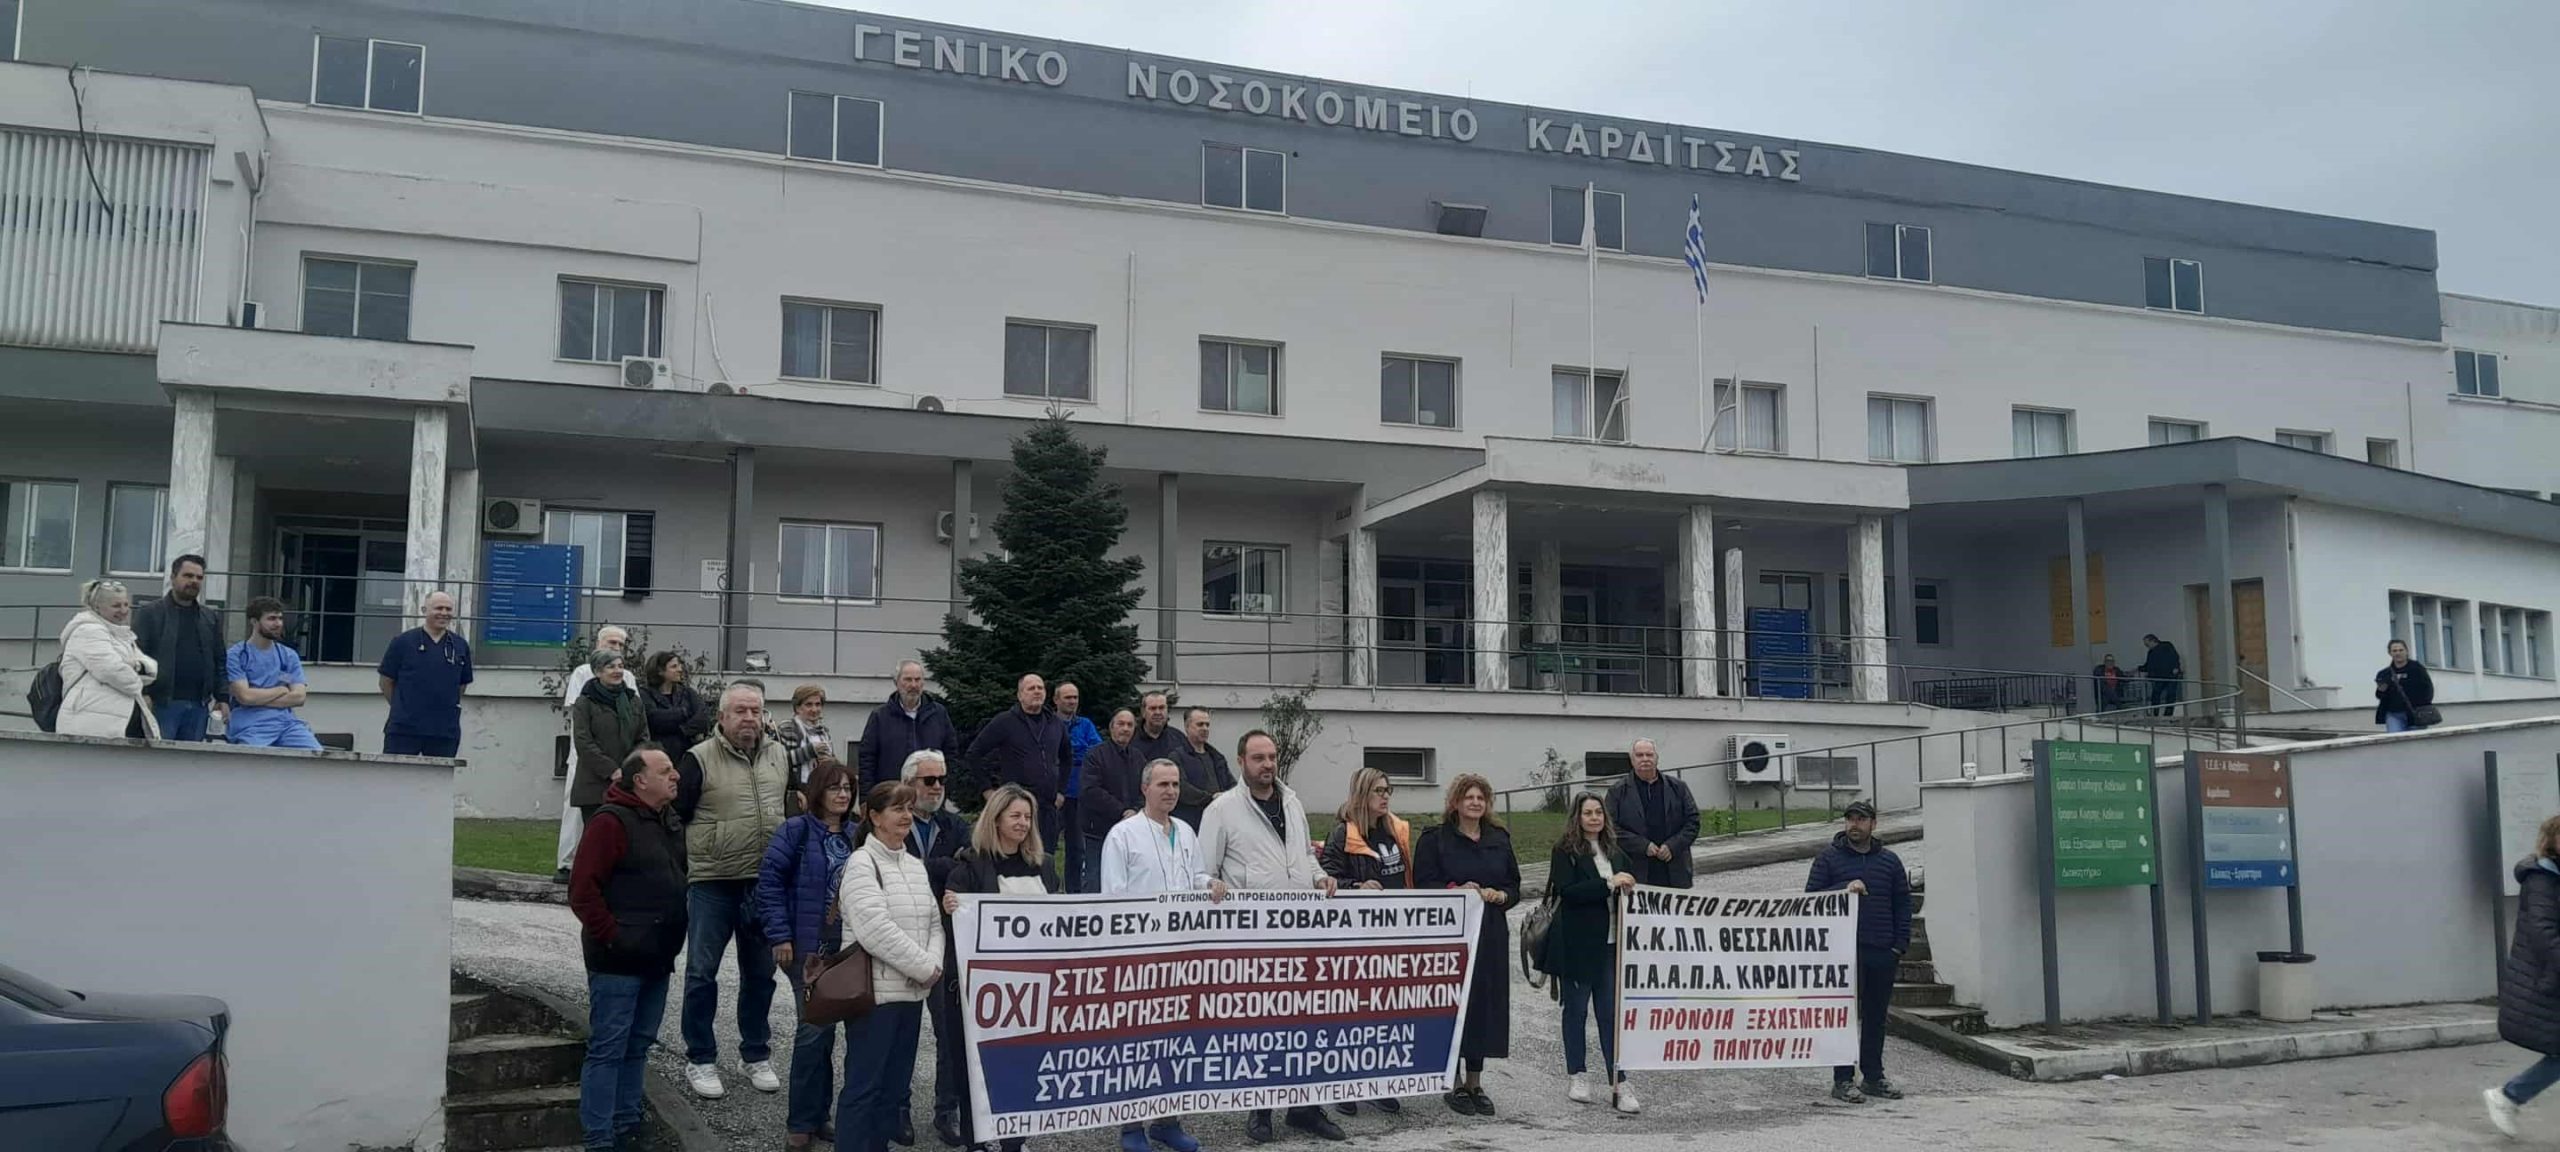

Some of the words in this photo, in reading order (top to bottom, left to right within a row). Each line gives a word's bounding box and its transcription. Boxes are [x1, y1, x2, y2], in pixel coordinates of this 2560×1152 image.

[855, 23, 1069, 87] ΓΕΝΙΚΟ
[1127, 61, 1479, 142] ΝΟΣΟΚΟΜΕΙΟ
[1527, 116, 1802, 181] ΚΑΡΔΙΤΣΑΣ
[1158, 894, 1168, 904] ΟΙ
[1238, 892, 1326, 902] ΠΡΟΕΙΔΟΠΟΙΟΥΝ:
[1627, 890, 1720, 917] ΣΩΜΑΤΕΙΟ
[1721, 893, 1850, 918] ΕΡΓΑΖΟΜΕΝΩΝ
[994, 915, 1031, 938] ΤΟ
[1040, 915, 1104, 938] «ΝΕΟ
[1110, 912, 1161, 935] ΕΣΥ»
[1167, 909, 1258, 932] ΒΛΑΠΤΕΙ
[1266, 908, 1352, 929] ΣΟΒΑΡΑ
[1358, 908, 1398, 928] ΤΗΝ
[1404, 907, 1457, 926] ΥΓΕΙΑ
[1626, 926, 1713, 952] Κ.Κ.Π.Π.
[1719, 927, 1830, 952] ΘΕΣΣΑΛΙΑΣ
[1052, 966, 1107, 998] ΣΤΙΣ
[1113, 956, 1309, 993] ΙΔΙΩΤΙΚΟΠΟΙΗΣΕΙΣ
[1314, 951, 1461, 982] ΣΥΓΧΩΝΕΥΣΕΙΣ
[1624, 964, 1731, 990] Π.Α.Α.Π.Α.
[1736, 964, 1850, 990] ΚΑΡΔΙΤΣΑΣ
[975, 982, 1042, 1030] ΟΧΙ
[1050, 993, 1192, 1034] ΚΑΤΑΡΓΗΣΕΙΣ
[1198, 983, 1463, 1020] ΝΟΣΟΚΟΜΕΙΩΝ-ΚΛΙΝΙΚΩΝ
[1624, 1008, 1637, 1031] Η
[1650, 1008, 1734, 1031] ΠΡΟΝΟΙΑ
[1747, 1006, 1849, 1031] ΞΕΧΑΣΜΕΝΗ
[1038, 1035, 1196, 1073] ΑΠΟΚΛΕΙΣΤΙΚΑ
[1204, 1030, 1308, 1055] ΔΗΜΟΣΙΟ
[1314, 1029, 1329, 1049] &
[1335, 1023, 1416, 1048] ΔΩΡΕΑΝ
[1663, 1038, 1701, 1062] ΑΠΟ
[1713, 1038, 1787, 1061] ΠΑΝΤΟΥ
[1035, 1064, 1163, 1102] ΣΥΣΤΗΜΑ
[1170, 1044, 1415, 1085] ΥΓΕΙΑΣ-ΠΡΟΝΟΙΑΣ
[1038, 1107, 1101, 1131] ΙΑΤΡΩΝ
[1107, 1086, 1311, 1122] ΝΟΣΟΚΟΜΕΙΟΥ-ΚΕΝΤΡΩΝ
[1315, 1081, 1365, 1101] ΥΓΕΙΑΣ
[1368, 1080, 1383, 1096] Ν.
